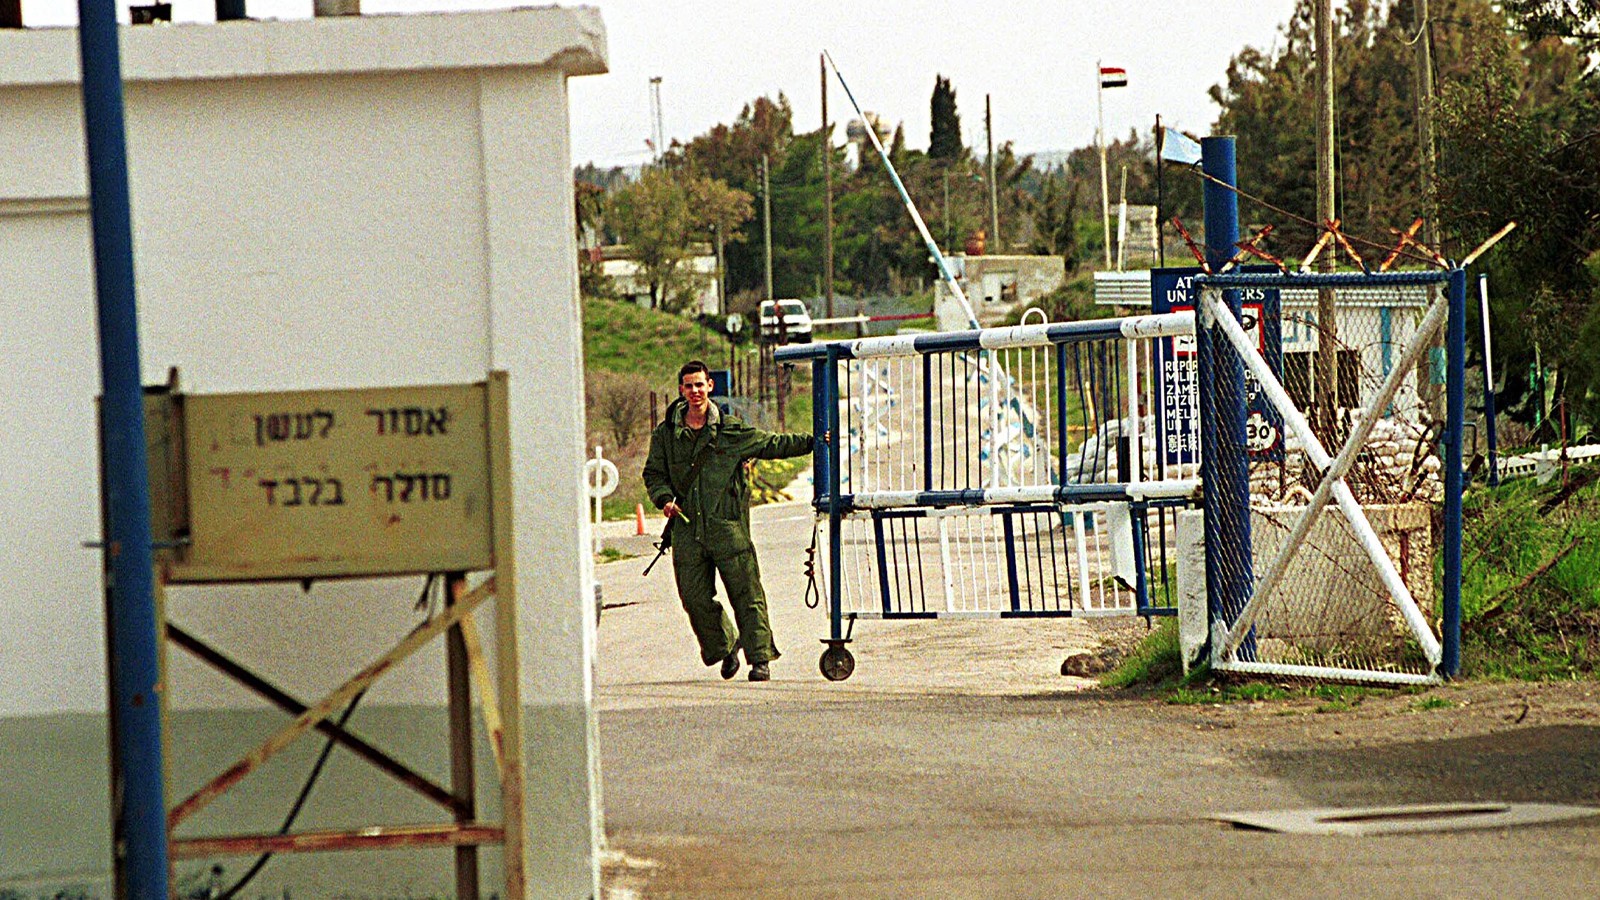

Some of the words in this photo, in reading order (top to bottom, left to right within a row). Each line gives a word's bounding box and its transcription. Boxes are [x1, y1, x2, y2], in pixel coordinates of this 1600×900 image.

[254, 408, 335, 447] לעשן
[365, 406, 450, 436] אסור
[1246, 423, 1270, 439] 30
[258, 476, 346, 507] בלבד
